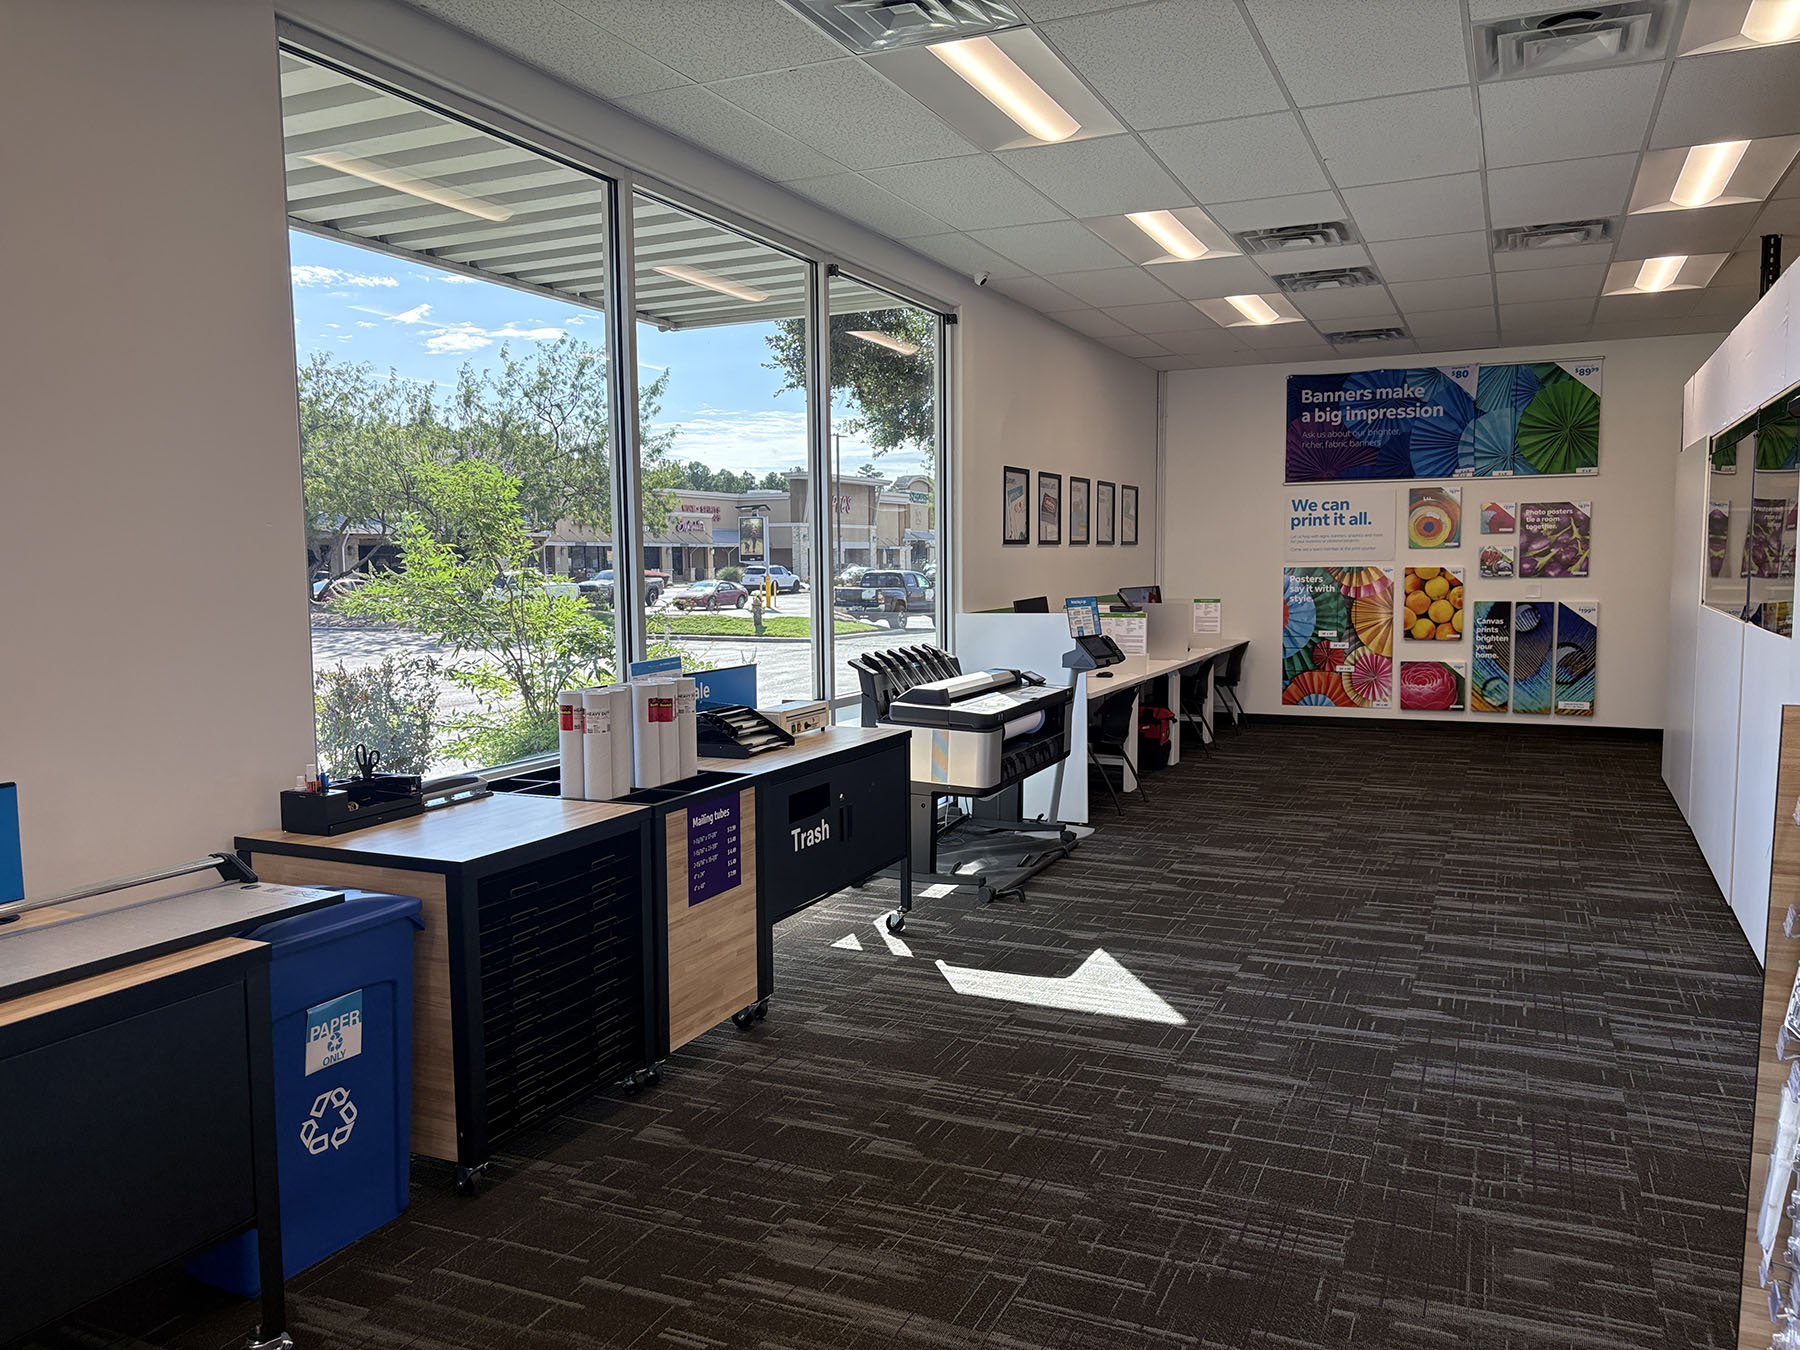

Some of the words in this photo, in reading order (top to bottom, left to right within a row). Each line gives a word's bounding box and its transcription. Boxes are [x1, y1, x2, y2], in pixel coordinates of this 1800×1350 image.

[1451, 369, 1469, 379] $80
[1301, 388, 1373, 404] Banners
[1376, 383, 1426, 399] make
[1301, 411, 1311, 423] a
[1314, 407, 1342, 426] big
[1345, 402, 1444, 424] impression
[1302, 430, 1316, 439] Ask
[1316, 431, 1327, 439] us
[1327, 429, 1351, 439] about
[1352, 430, 1366, 438] our
[1367, 427, 1401, 438] brighter,
[1302, 440, 1324, 450] richer,
[1325, 438, 1348, 449] fabric
[1291, 499, 1318, 512] We
[1321, 500, 1350, 512] can
[1525, 508, 1546, 516] Photo
[1547, 508, 1574, 517] posters
[1290, 512, 1330, 531] print
[1333, 512, 1346, 526] it
[1349, 511, 1372, 526] all.
[1289, 575, 1324, 583] Posters
[1289, 584, 1305, 594] say
[1305, 584, 1313, 592] it
[1314, 584, 1336, 592] with
[1289, 594, 1314, 604] style.
[1475, 634, 1509, 643] brighten
[692, 812, 714, 829] Mailing
[714, 807, 730, 821] tubes
[791, 818, 830, 852] Trash
[310, 1009, 361, 1042] PAPER
[322, 1049, 346, 1066] ONLY
